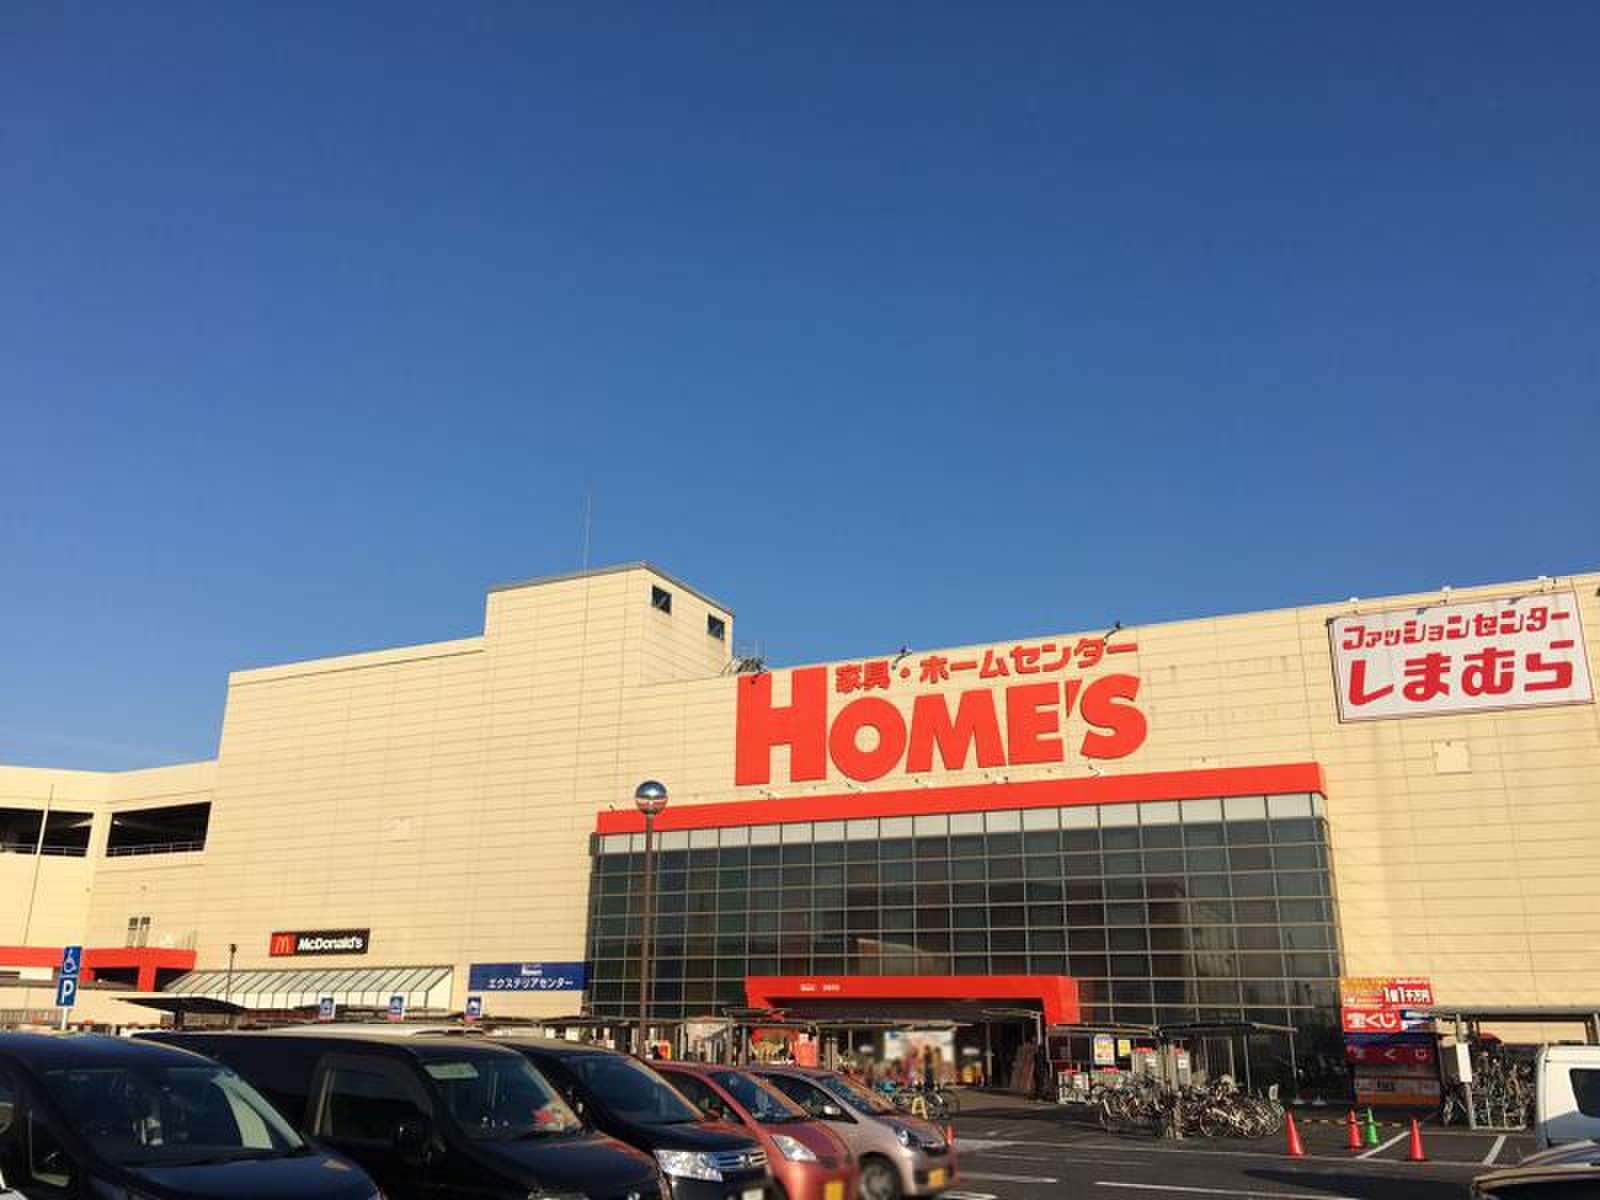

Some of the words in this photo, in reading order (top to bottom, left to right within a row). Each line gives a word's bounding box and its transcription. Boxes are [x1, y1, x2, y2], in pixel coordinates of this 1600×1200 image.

[1343, 607, 1570, 650] ファッションセンター
[835, 637, 1138, 693] 家具・ホームセンター
[1349, 640, 1575, 705] しまむら
[735, 667, 1148, 785] HOME'S
[297, 937, 363, 951] McDonald's
[61, 980, 74, 1004] P
[486, 977, 574, 989] エクステリアセンター
